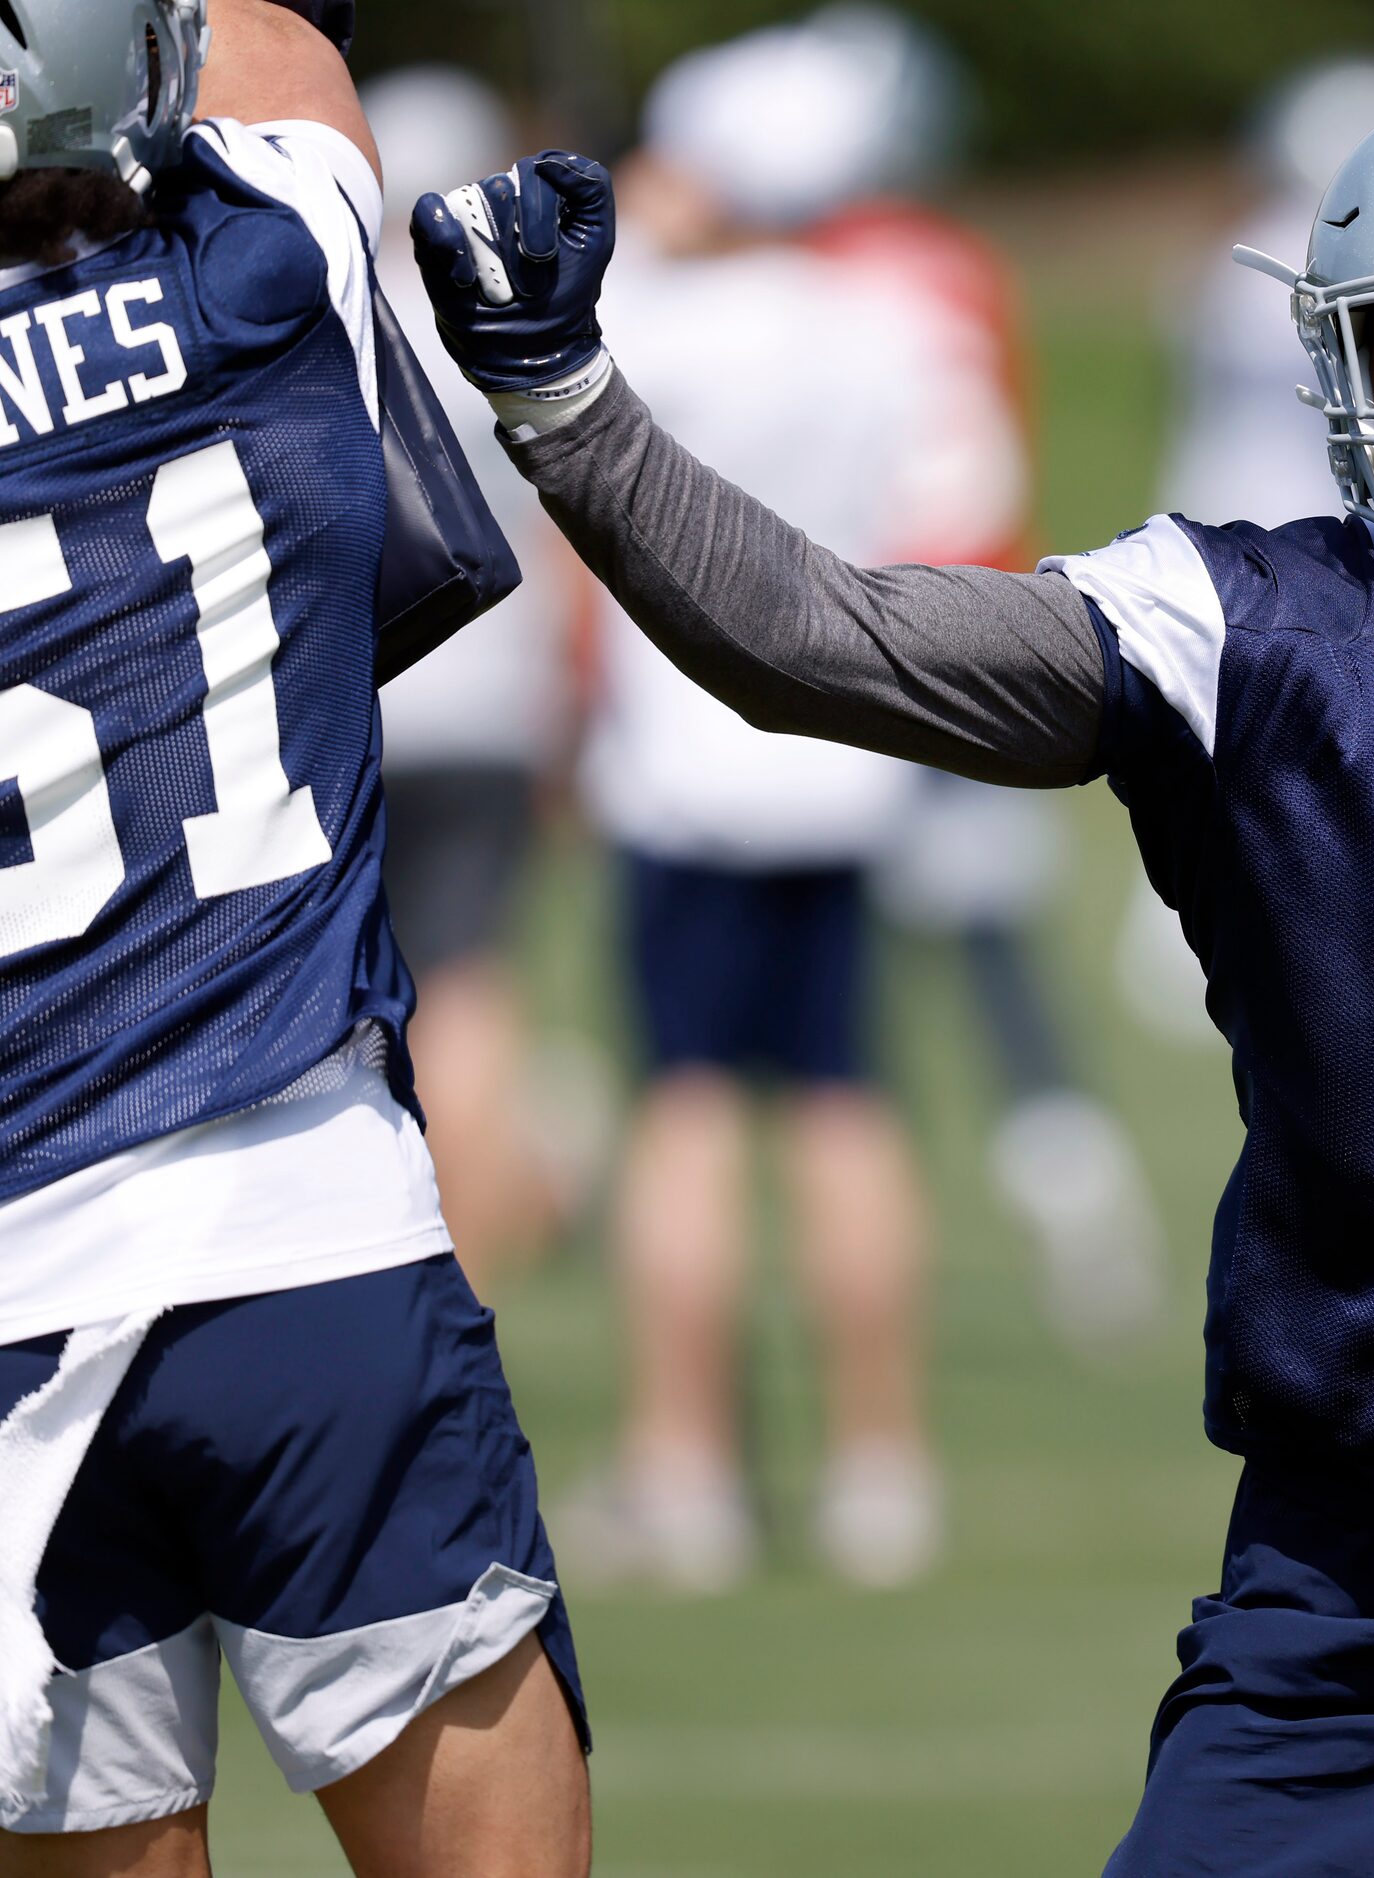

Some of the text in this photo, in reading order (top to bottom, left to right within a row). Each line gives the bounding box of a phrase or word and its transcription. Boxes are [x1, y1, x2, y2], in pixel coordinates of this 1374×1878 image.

[0, 277, 188, 447] NES
[526, 377, 590, 398] BE GREAT
